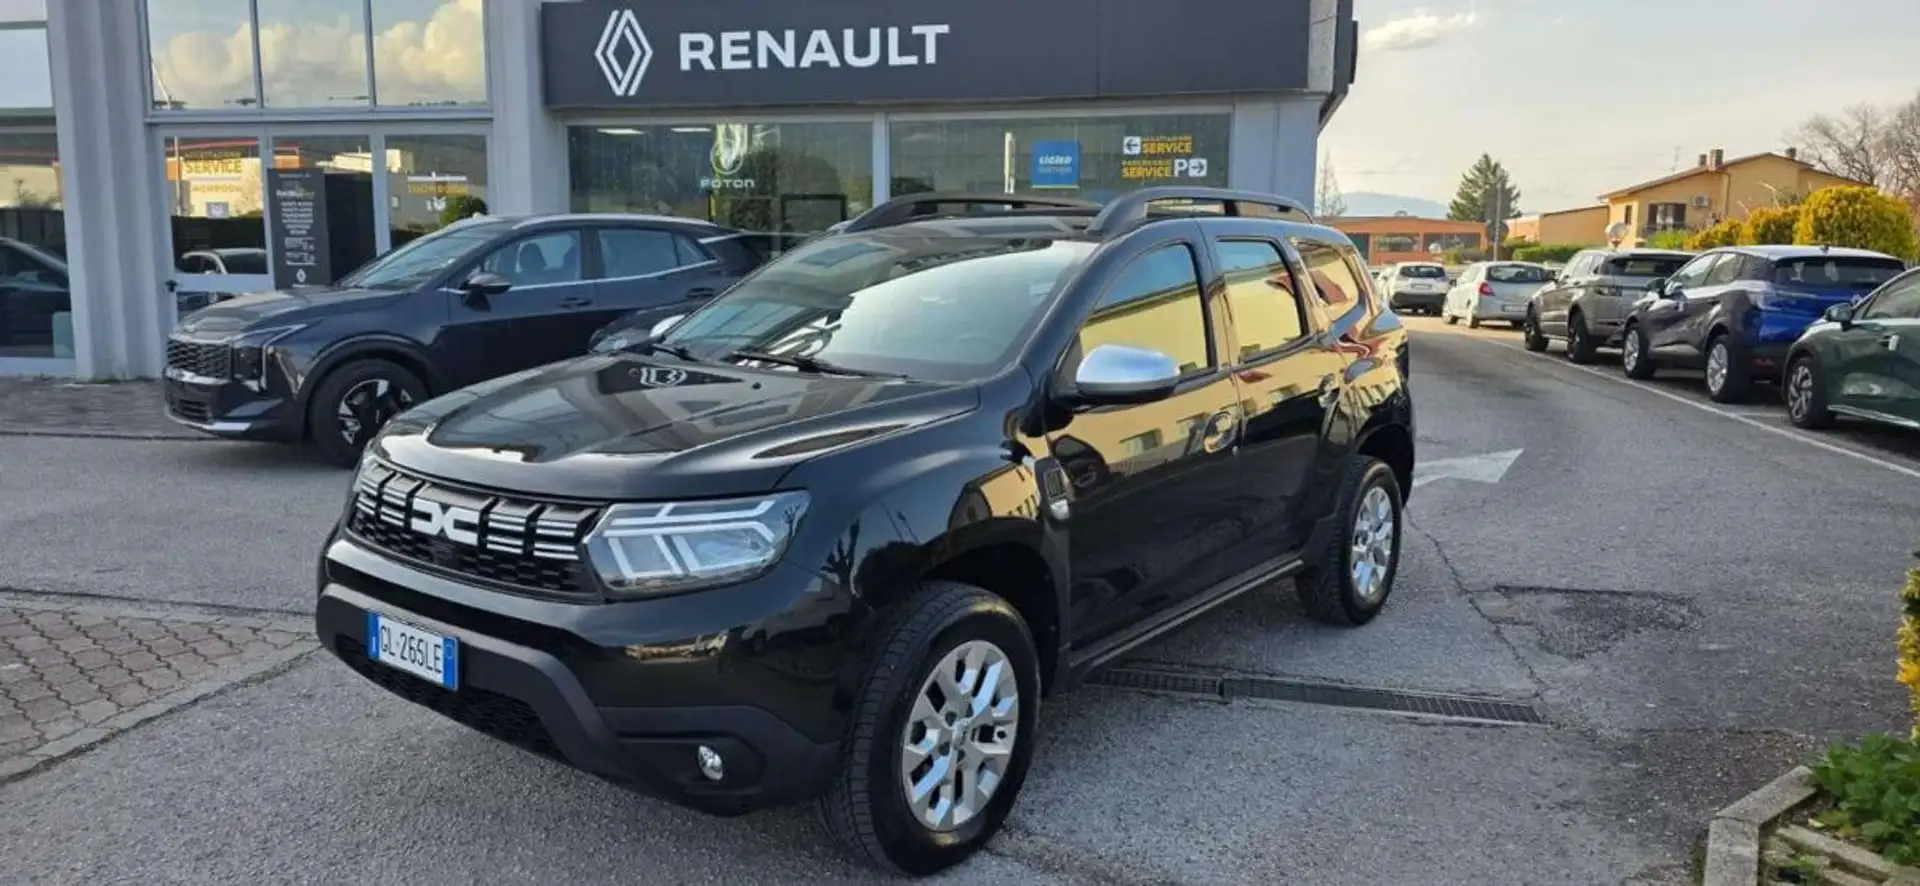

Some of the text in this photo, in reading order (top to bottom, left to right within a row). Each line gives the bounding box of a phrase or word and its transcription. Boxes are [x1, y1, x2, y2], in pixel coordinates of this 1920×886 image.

[679, 24, 950, 71] RENAULT
[1142, 142, 1192, 154] SERVICE
[184, 160, 243, 174] SERVICE
[1121, 159, 1188, 178] SERVICE P
[700, 179, 755, 188] FOTON
